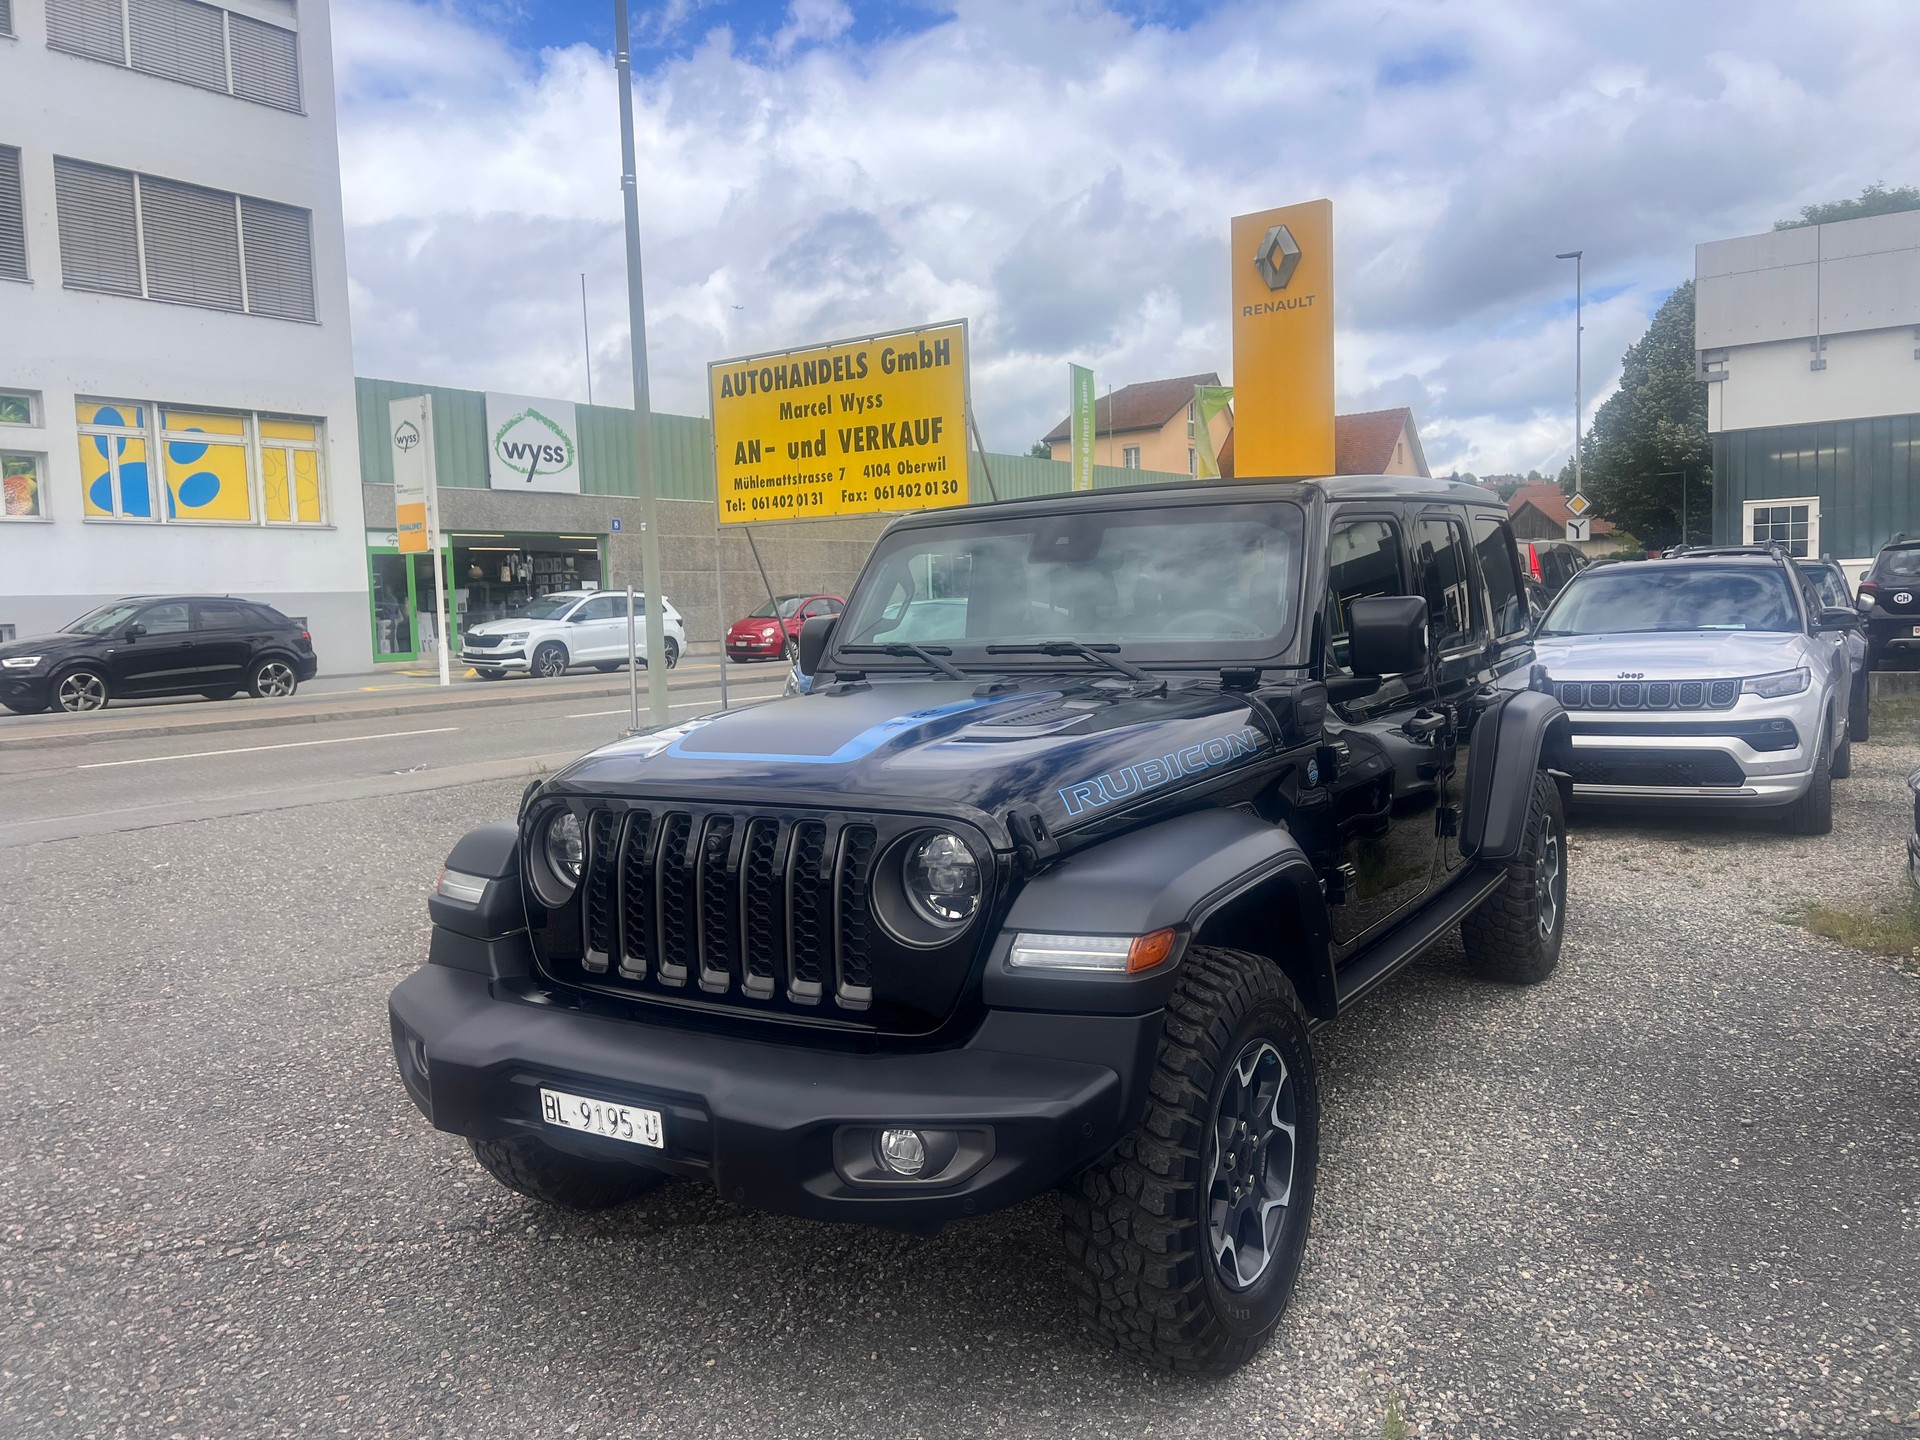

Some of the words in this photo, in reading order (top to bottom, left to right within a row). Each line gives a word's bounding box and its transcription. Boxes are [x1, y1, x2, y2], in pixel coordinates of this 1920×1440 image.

[1243, 295, 1315, 317] RENAULT
[721, 352, 868, 398] AUTOHANDELS
[881, 339, 950, 374] GmbH
[780, 395, 832, 420] Marcel
[840, 393, 883, 414] Wyss
[396, 434, 417, 453] wyss
[734, 439, 775, 465] AN-
[788, 429, 826, 460] und
[838, 416, 943, 454] VERKAUF
[502, 441, 564, 482] wyss
[734, 472, 833, 490] Mühlemattstrasse
[839, 467, 846, 481] 7
[863, 463, 891, 478] 4104
[897, 456, 946, 475] Oberwil
[726, 498, 746, 512] Tel:
[841, 489, 867, 503] Fax:
[1896, 594, 1909, 602] CH
[1617, 671, 1645, 680] Jeep
[1058, 729, 1258, 816] RUBICON
